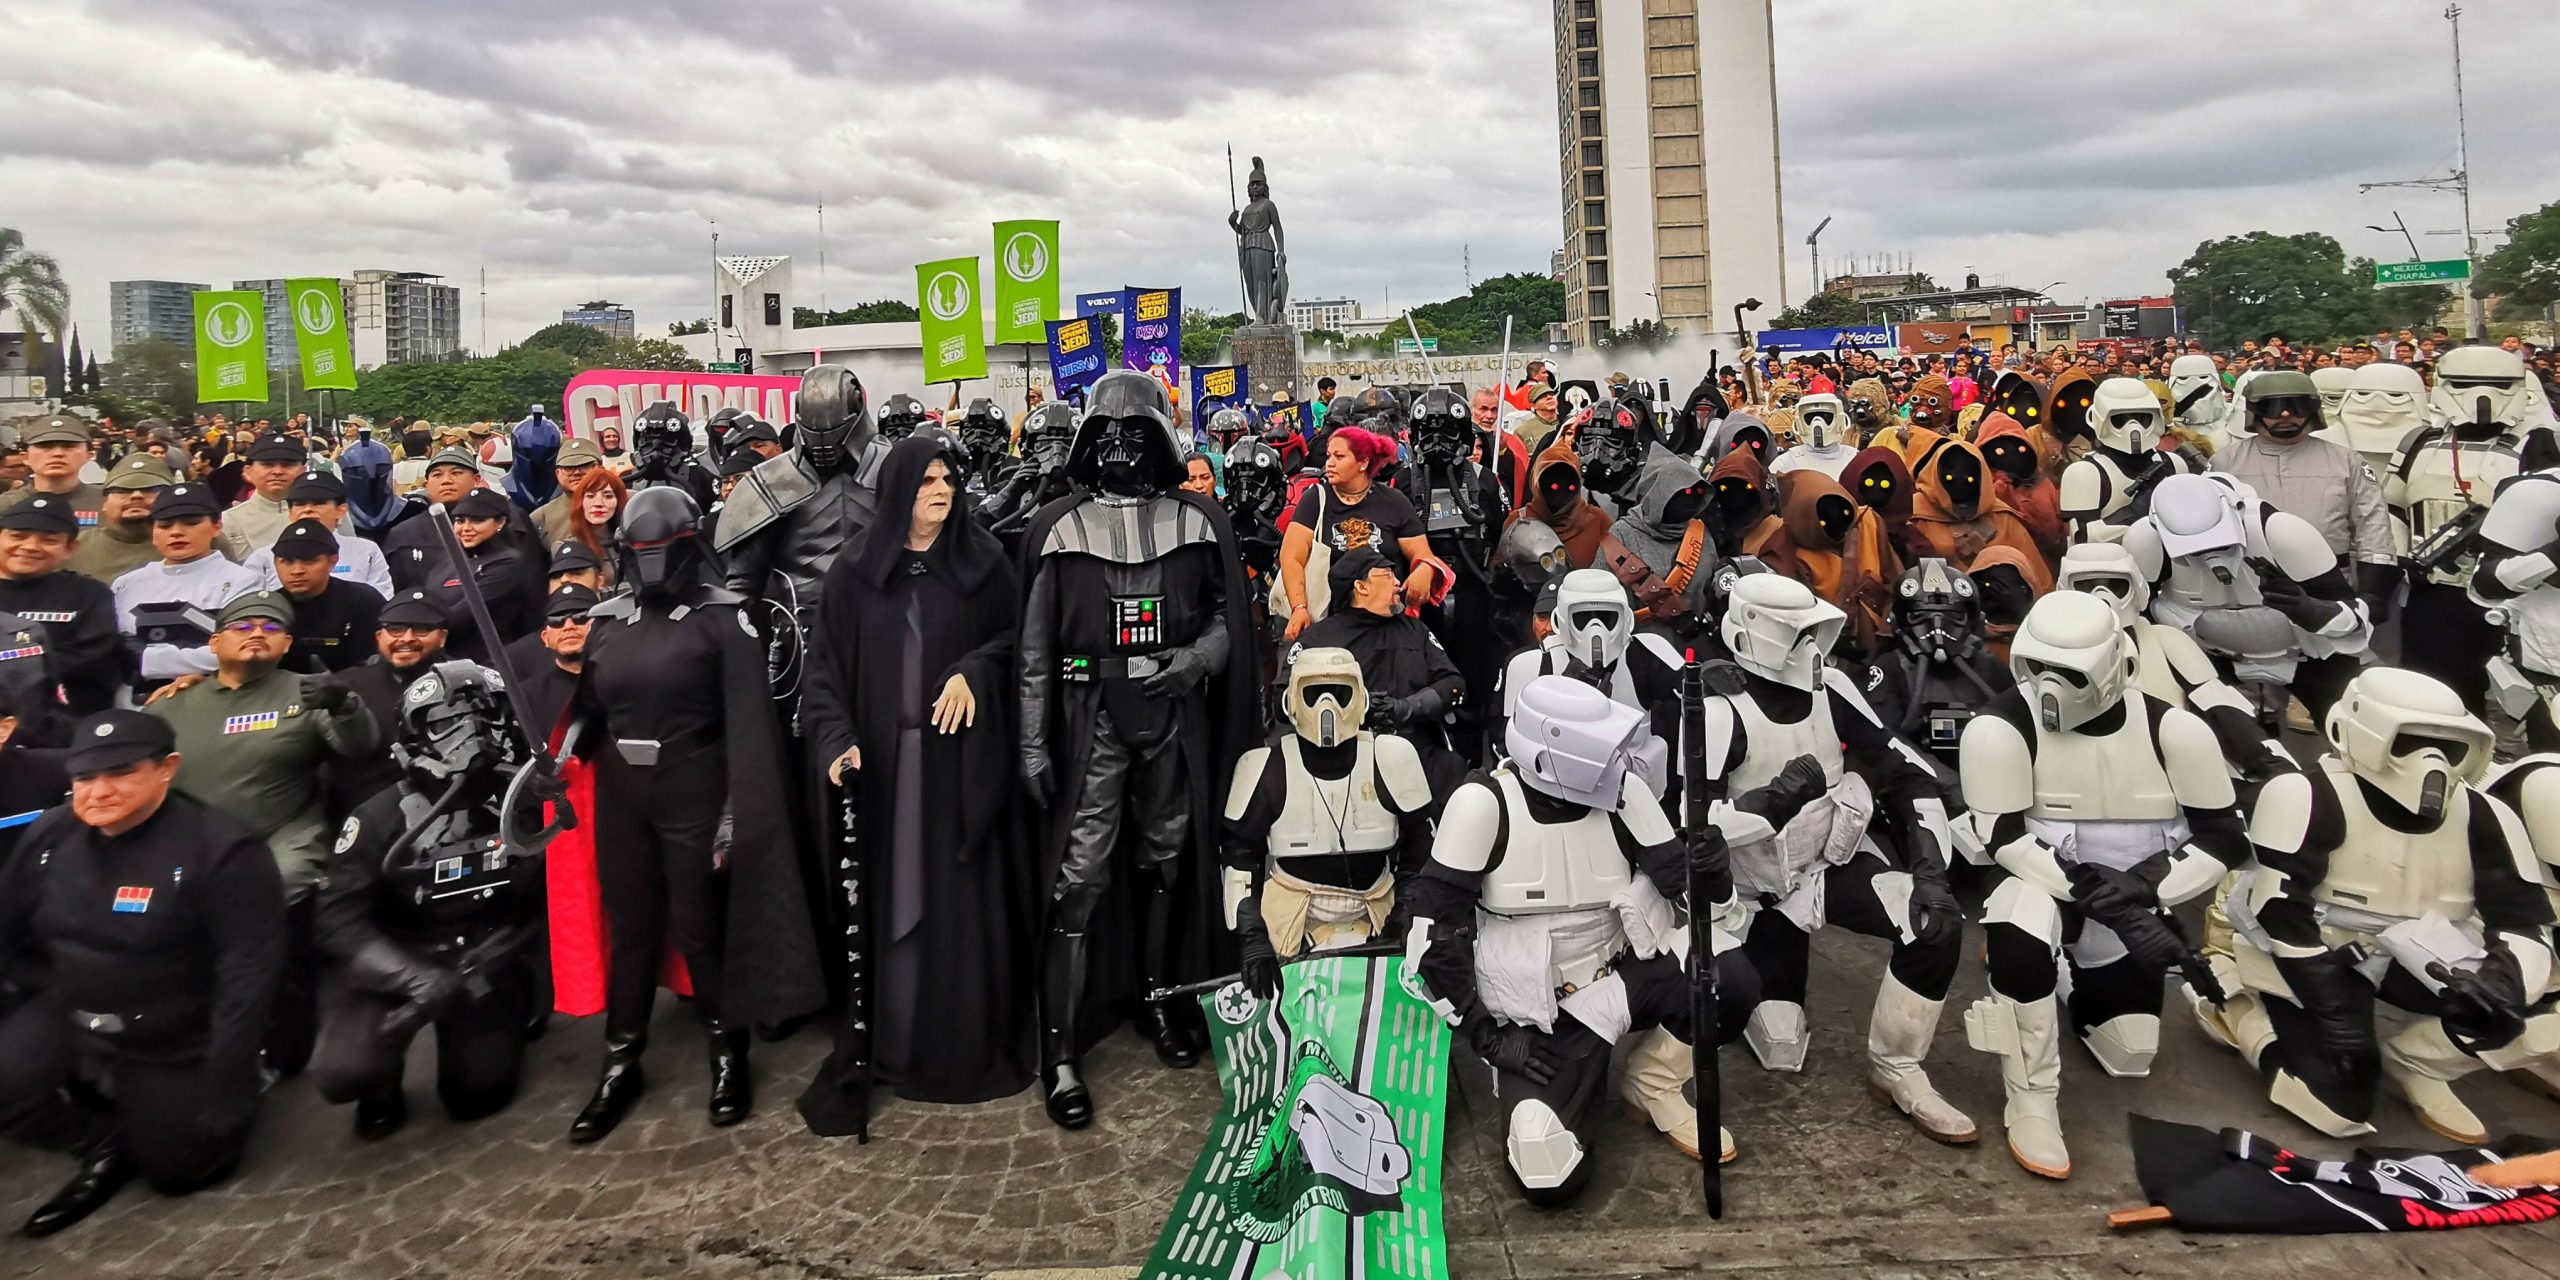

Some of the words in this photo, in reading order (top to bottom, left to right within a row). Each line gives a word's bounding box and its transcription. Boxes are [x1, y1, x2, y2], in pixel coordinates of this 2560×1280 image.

[2394, 271, 2438, 280] CHAPALA
[1086, 297, 1116, 307] VOLVO
[1016, 310, 1038, 326] JEDI
[1140, 304, 1165, 318] JEDI
[1062, 333, 1087, 350] JEDI
[943, 347, 964, 364] JEDI
[316, 359, 335, 374] JEDI
[1303, 361, 1383, 376] CUSTODIAN
[1208, 381, 1233, 396] JEDI
[1233, 1125, 1269, 1178] ENDOR
[1233, 1211, 1291, 1244] SCOUTING
[1292, 1185, 1350, 1224] PATROL
